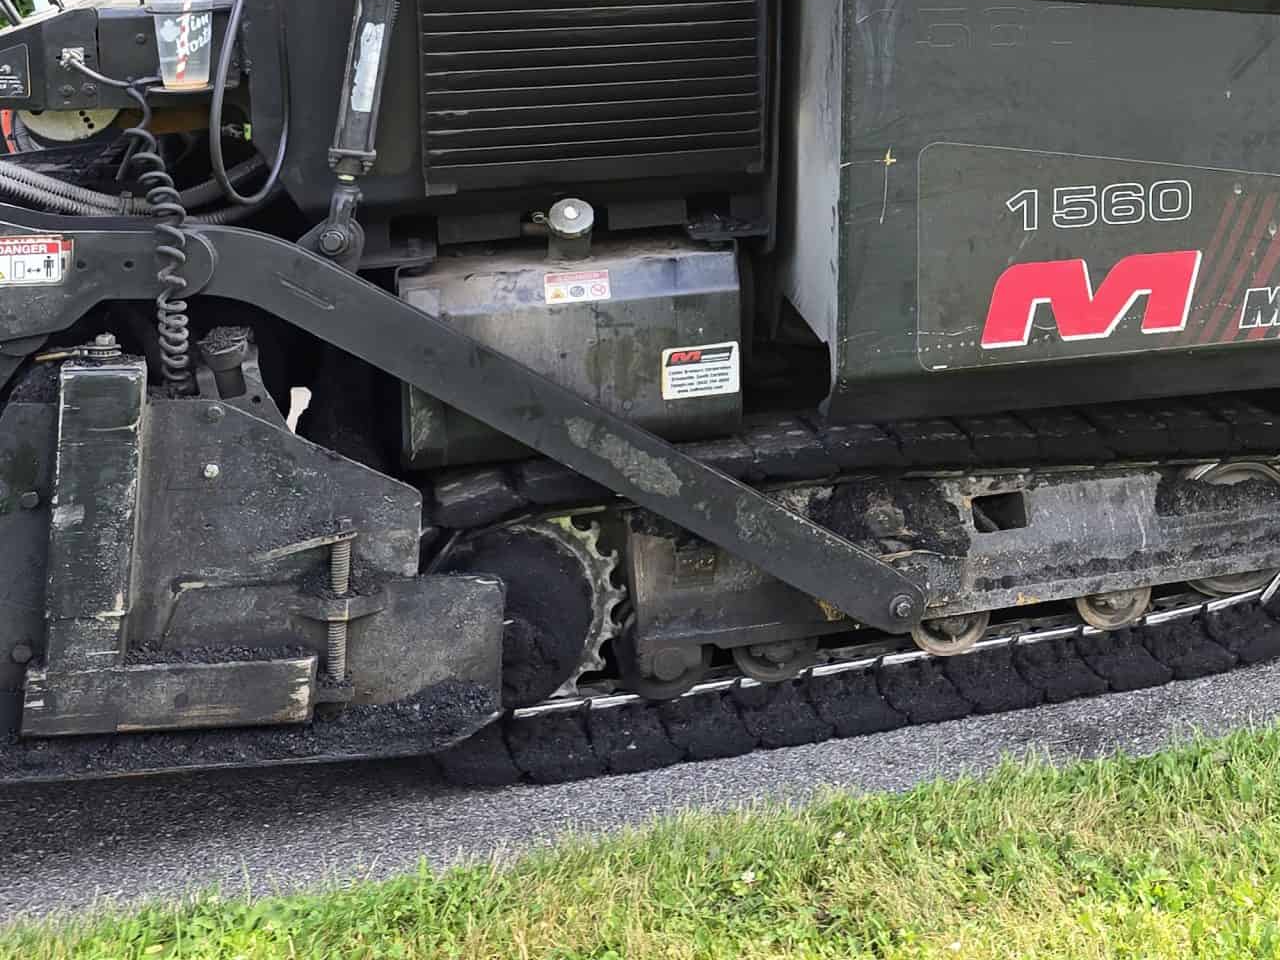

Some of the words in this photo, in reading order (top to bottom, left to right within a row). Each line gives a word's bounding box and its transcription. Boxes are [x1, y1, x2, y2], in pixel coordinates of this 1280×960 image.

[1006, 180, 1192, 231] 1560
[0, 243, 48, 255] DANGER
[980, 250, 1203, 349] M
